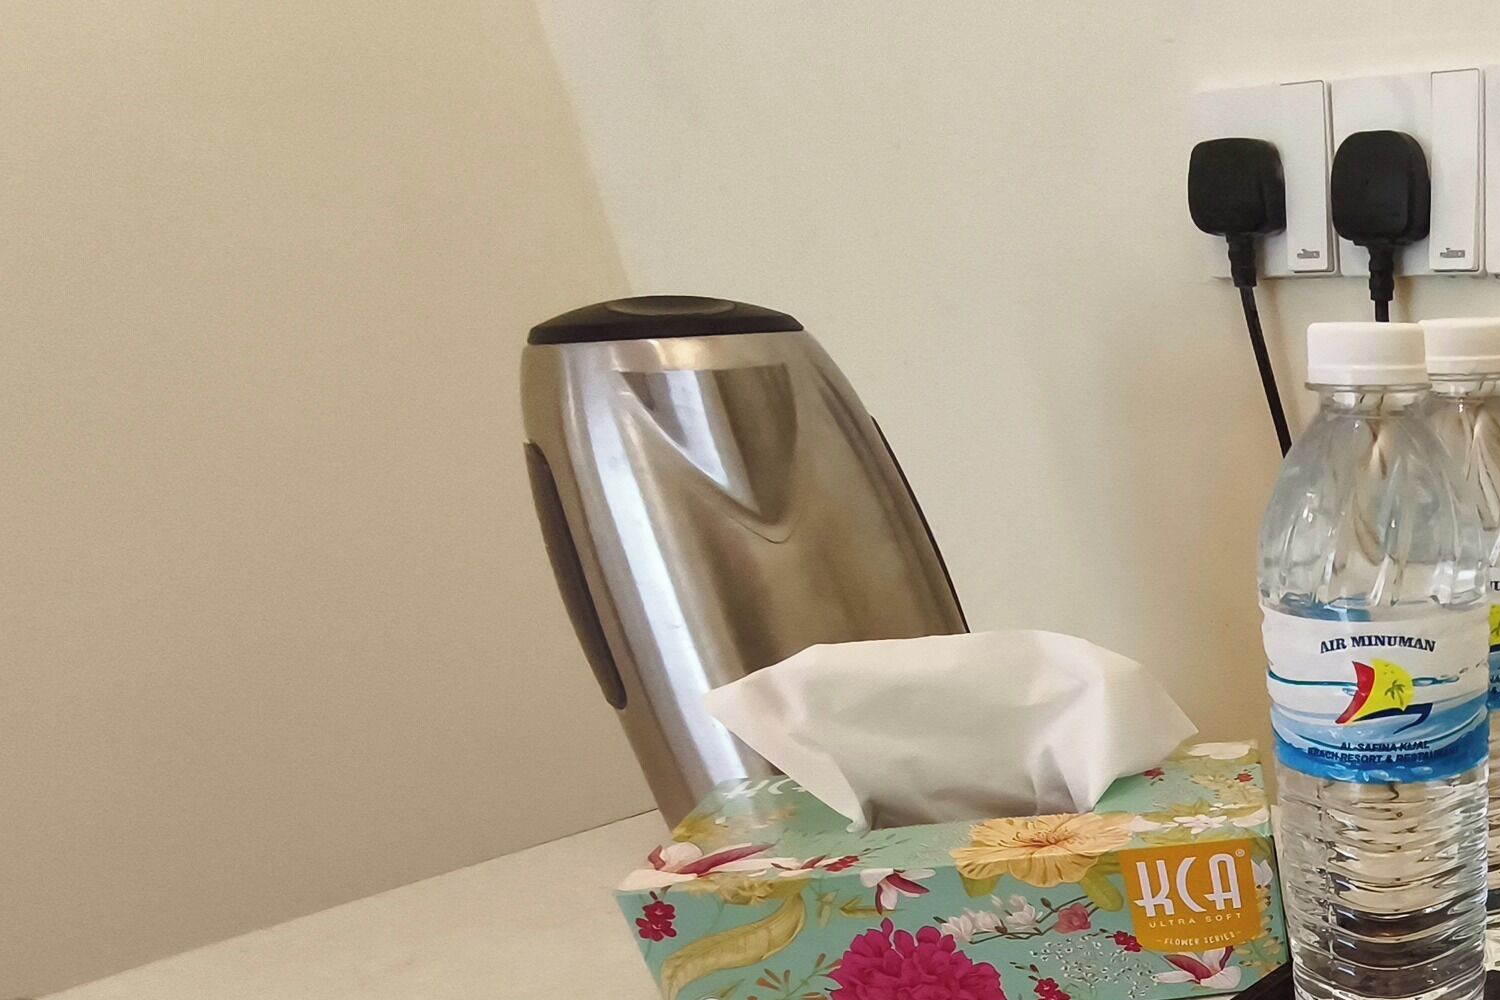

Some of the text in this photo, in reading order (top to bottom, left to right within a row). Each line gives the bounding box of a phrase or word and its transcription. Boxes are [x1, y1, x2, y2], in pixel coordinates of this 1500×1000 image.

[1320, 635, 1436, 654] AIR MINUMAN
[1341, 751, 1384, 764] RESORT
[1385, 753, 1393, 763] &
[722, 778, 806, 799] KC
[1133, 853, 1242, 918] KCA
[1148, 912, 1241, 929] ULTRA SOFT
[1163, 931, 1236, 946] FLOWER SERIES
